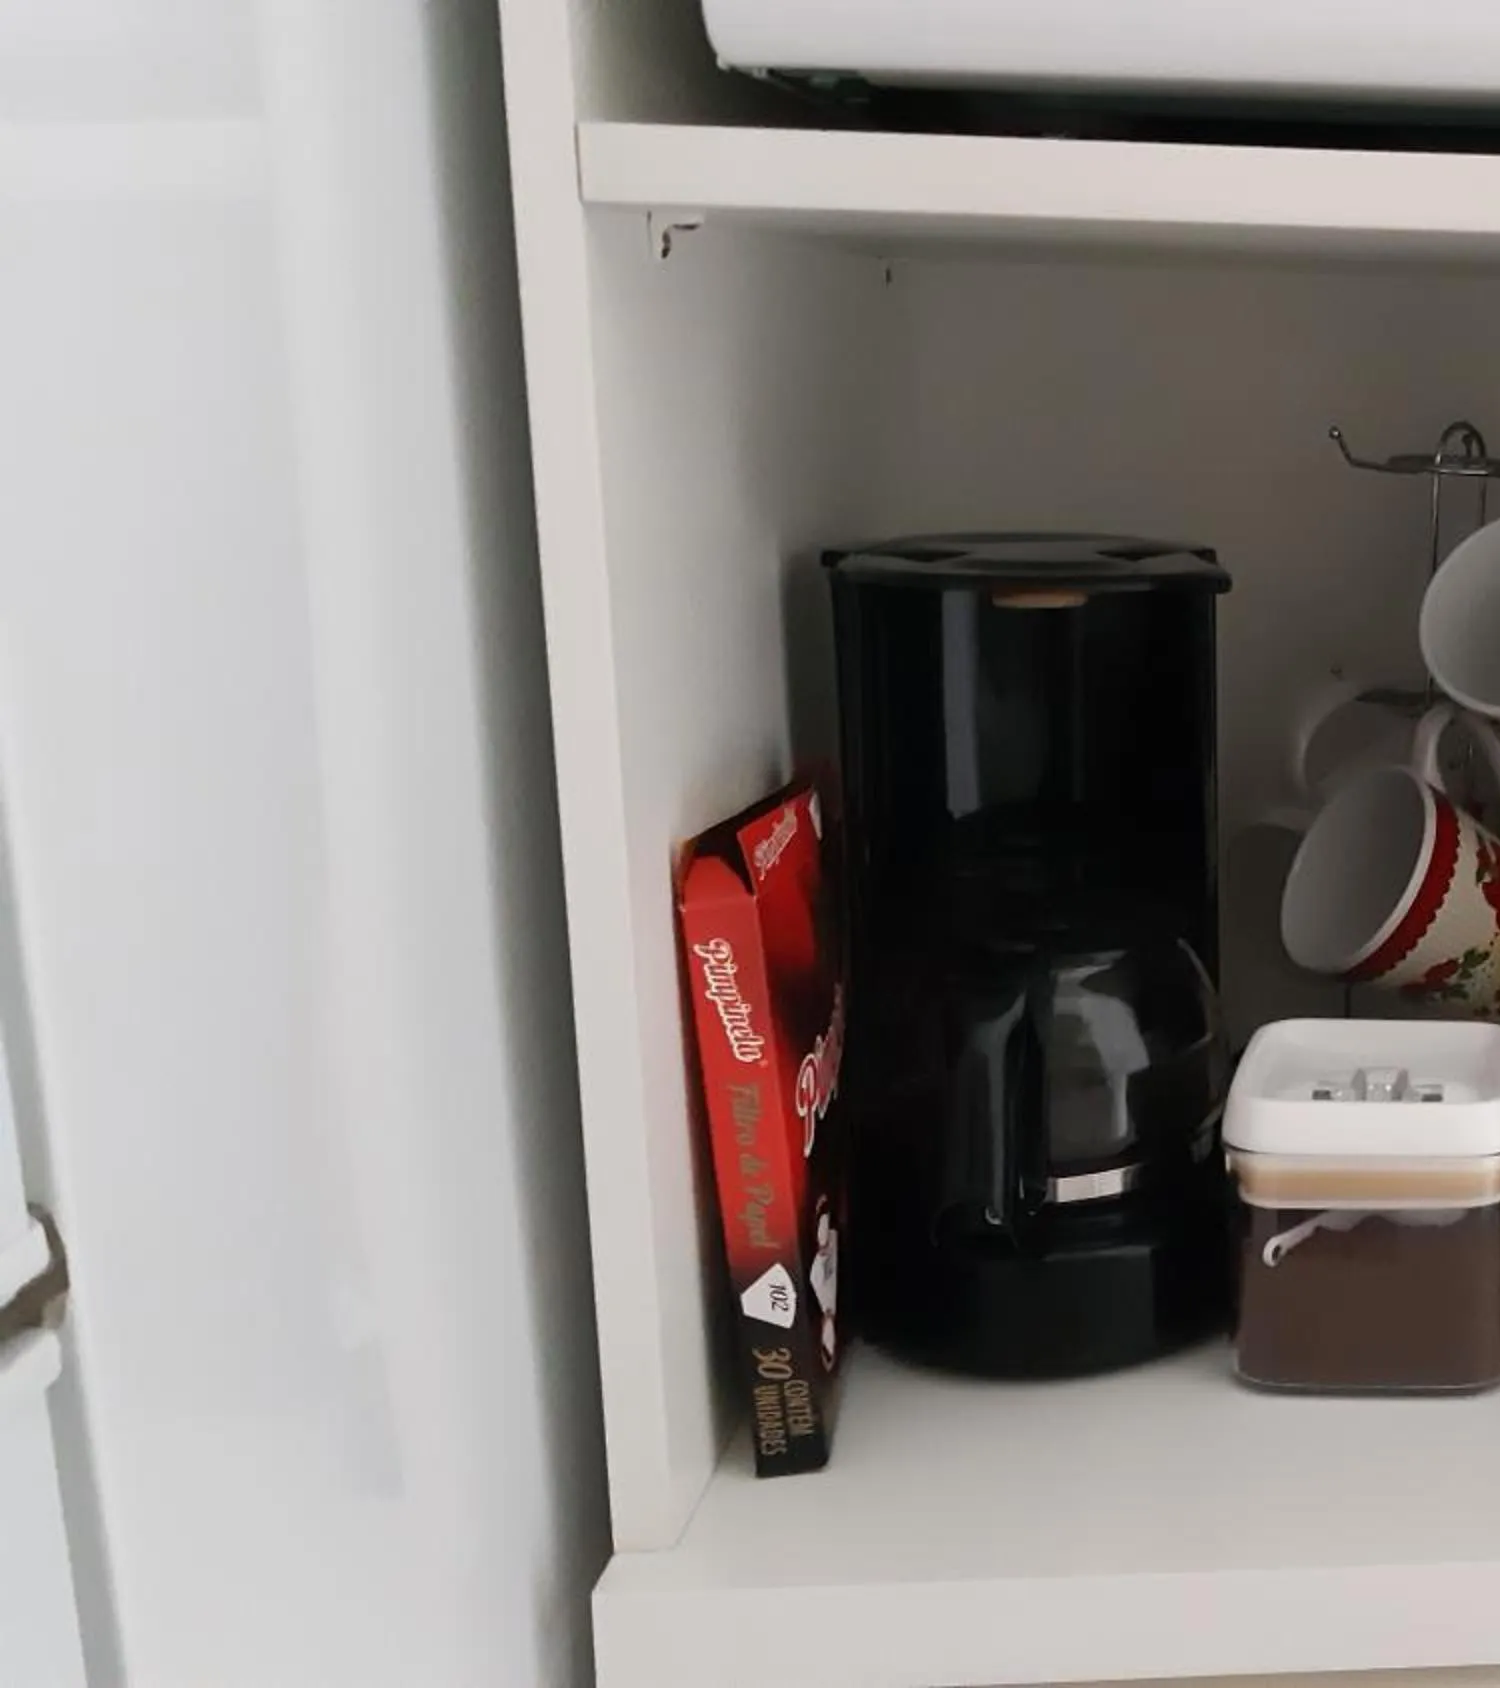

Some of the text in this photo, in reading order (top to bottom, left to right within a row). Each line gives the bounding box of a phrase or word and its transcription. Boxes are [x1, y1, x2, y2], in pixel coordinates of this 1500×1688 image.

[770, 1283, 789, 1311] 102
[751, 1346, 794, 1380] 30
[753, 1383, 788, 1456] UNIDADES
